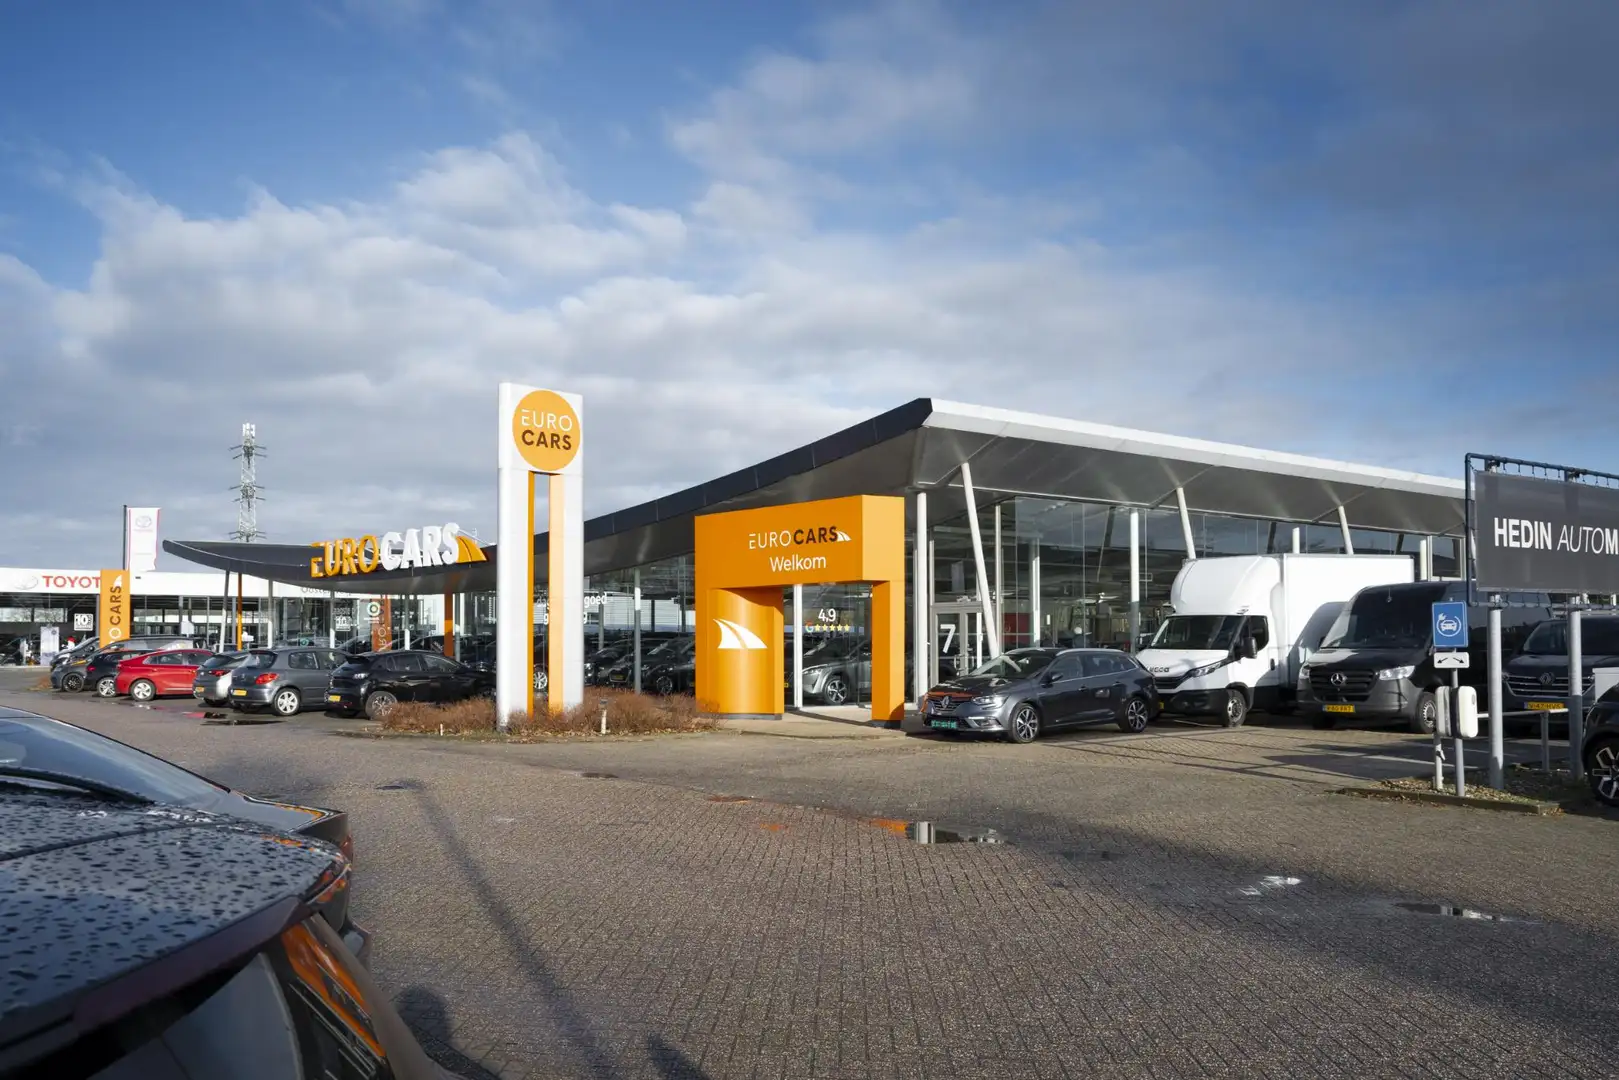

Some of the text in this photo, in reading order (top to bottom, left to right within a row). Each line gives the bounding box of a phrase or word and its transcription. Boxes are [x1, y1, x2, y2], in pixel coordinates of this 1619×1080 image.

[521, 408, 573, 432] EURO
[521, 429, 572, 451] CARS
[1494, 517, 1552, 550] HEDIN
[769, 554, 827, 573] Welkom
[818, 608, 837, 622] 4,9
[940, 624, 956, 654] 7
